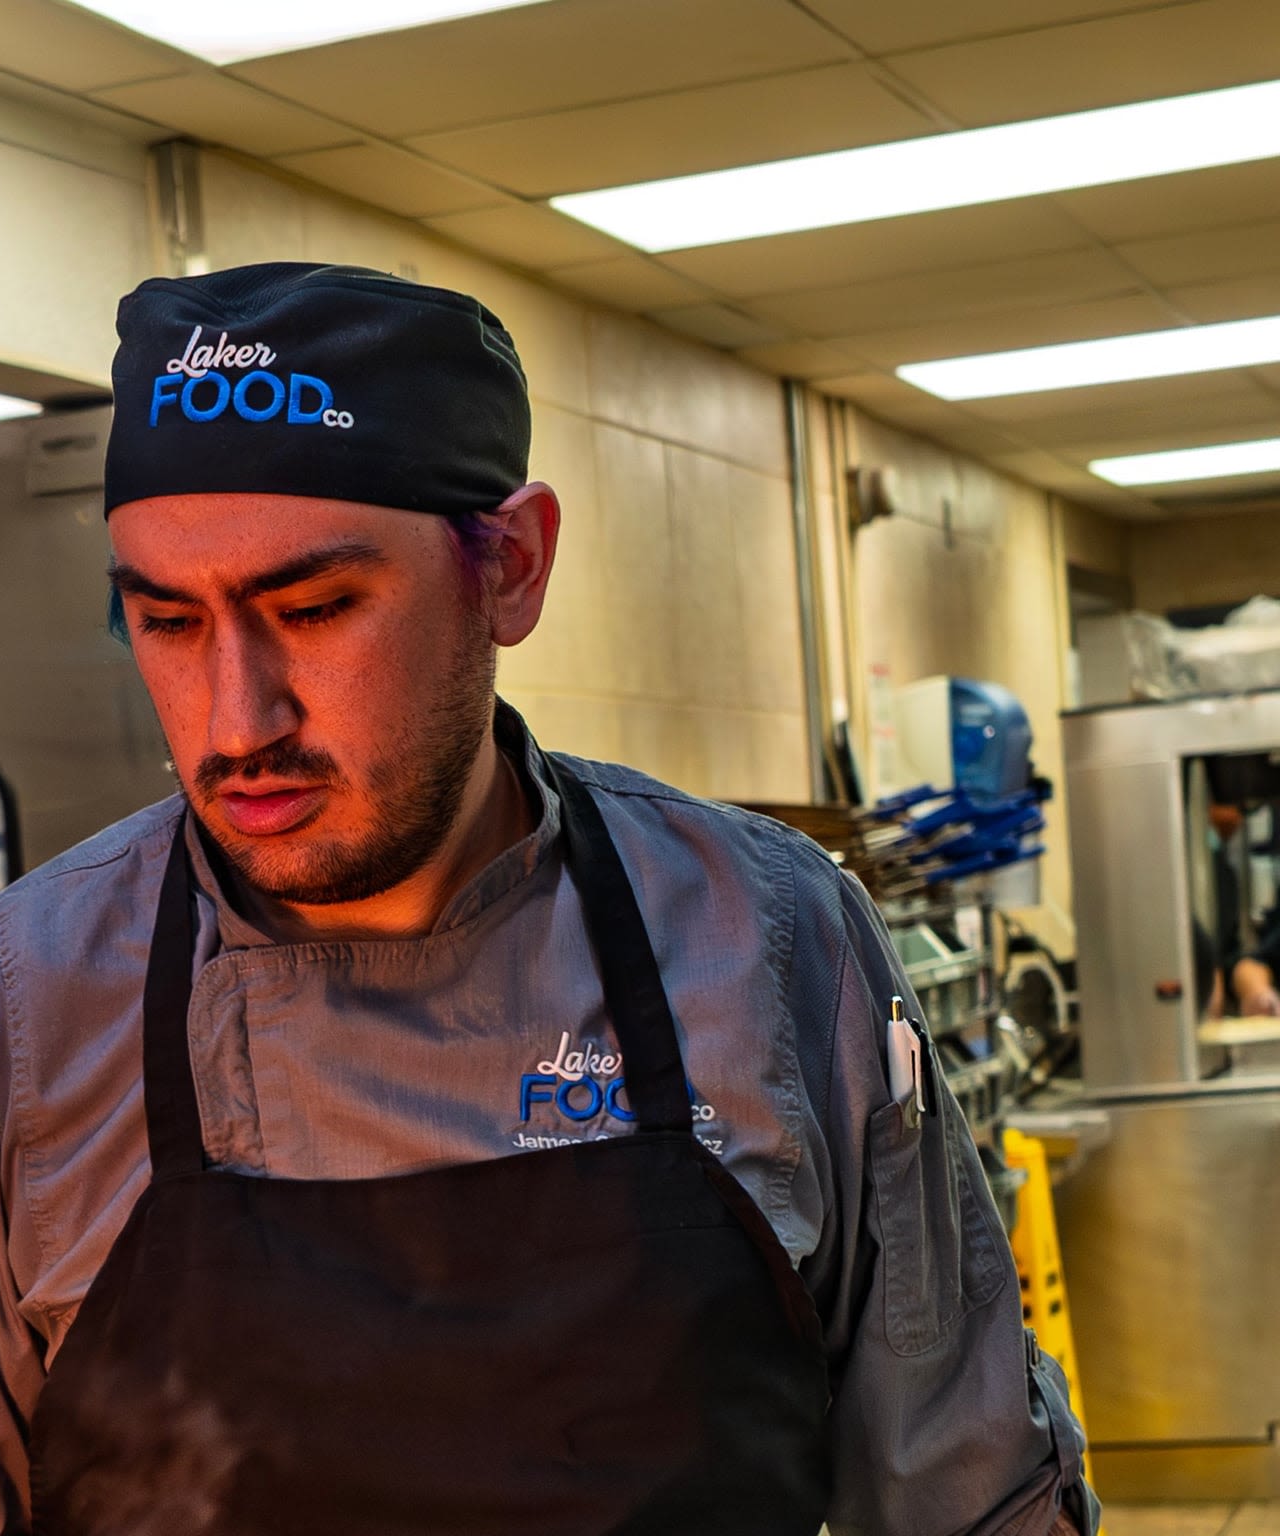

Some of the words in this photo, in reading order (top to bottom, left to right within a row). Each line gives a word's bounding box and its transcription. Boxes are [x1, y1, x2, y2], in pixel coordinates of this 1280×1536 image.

[166, 325, 276, 378] Laker
[149, 370, 334, 428] FOOD
[537, 1031, 624, 1081] Lake
